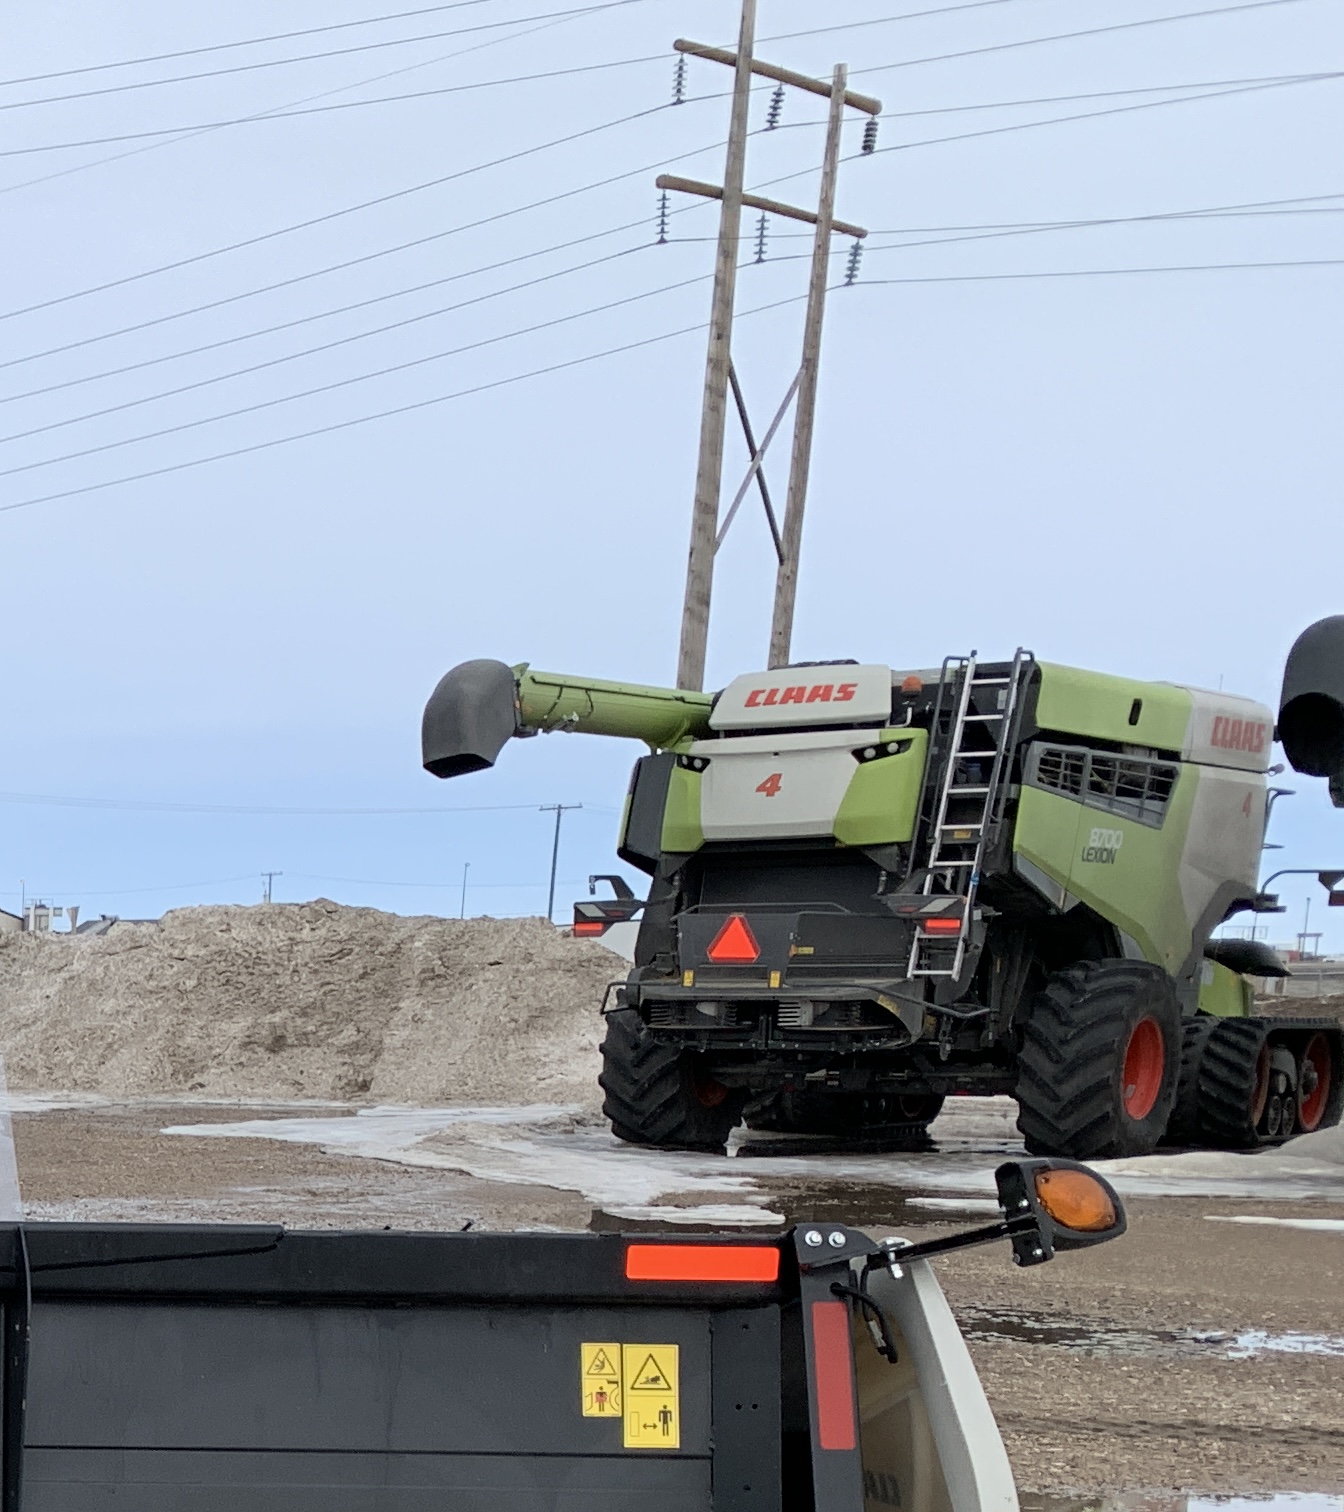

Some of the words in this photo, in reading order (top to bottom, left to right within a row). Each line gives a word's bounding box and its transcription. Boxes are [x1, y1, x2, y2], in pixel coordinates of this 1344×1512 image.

[744, 683, 859, 708] CLAAS
[1210, 716, 1266, 753] CLAAS
[755, 773, 783, 797] 4
[1089, 827, 1124, 849] 8700
[1081, 846, 1117, 864] LEXION
